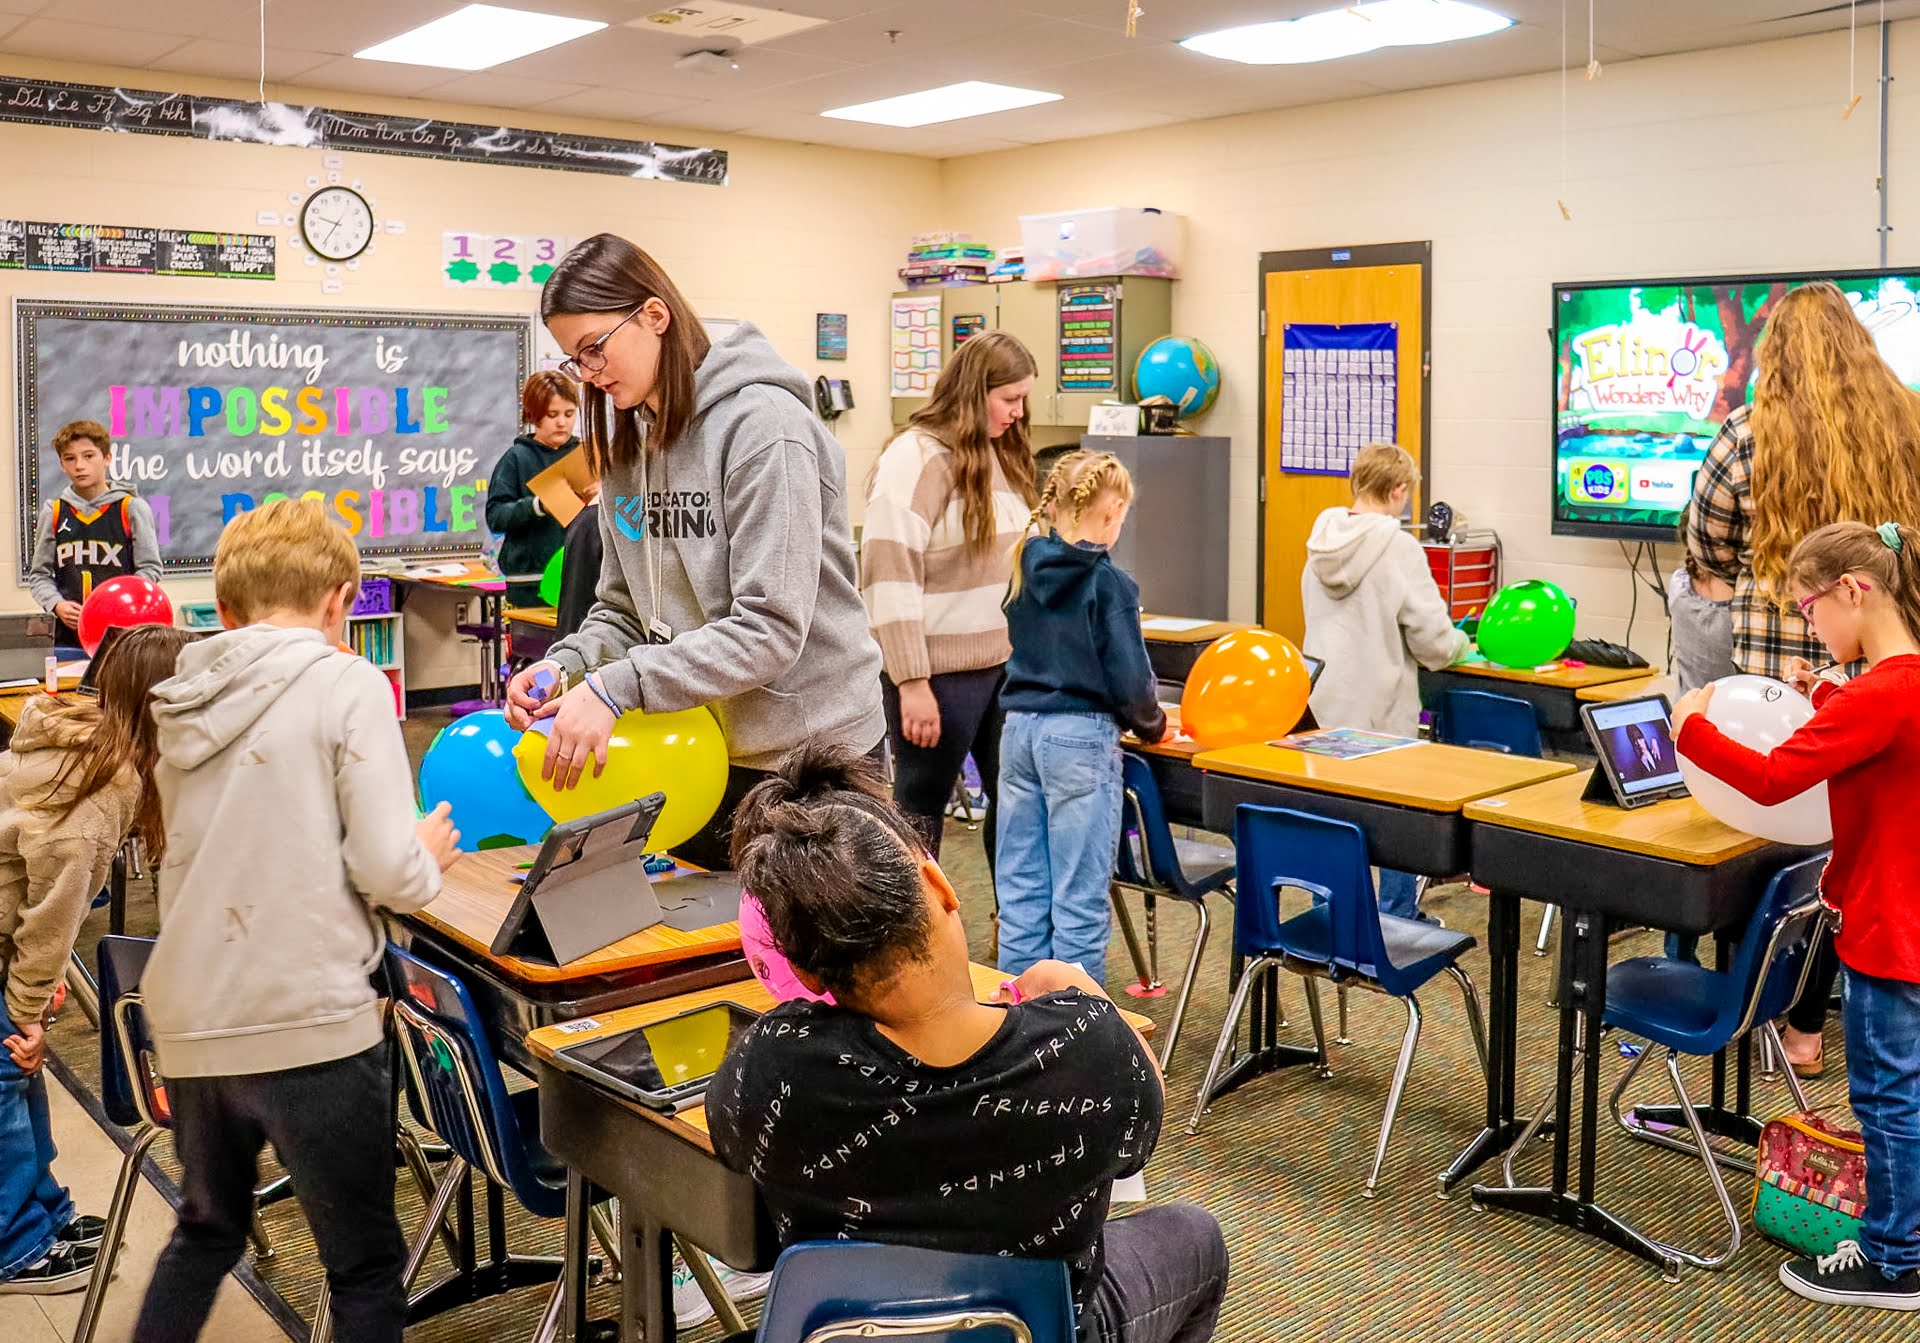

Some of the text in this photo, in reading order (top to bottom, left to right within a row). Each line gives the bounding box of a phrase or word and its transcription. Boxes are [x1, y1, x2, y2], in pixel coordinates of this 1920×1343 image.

[28, 224, 47, 236] RULE
[125, 229, 143, 239] RULE
[158, 230, 178, 242] RULE
[247, 235, 264, 246] RULE
[173, 244, 198, 253] MAKE
[453, 235, 556, 261] 1 2 3
[171, 252, 201, 261] SMART
[169, 260, 204, 270] CHOICES
[229, 261, 263, 273] HAPPY
[178, 329, 409, 385] nothing is
[1580, 332, 1721, 385] Elinor
[1593, 383, 1710, 412] Wonders Why
[109, 384, 450, 438] IMPOSSIBLE
[109, 438, 479, 490] the word itself says
[1585, 468, 1613, 486] PBS
[1587, 484, 1611, 495] KIDS
[1651, 480, 1674, 489] YouTube
[56, 540, 124, 568] PHX
